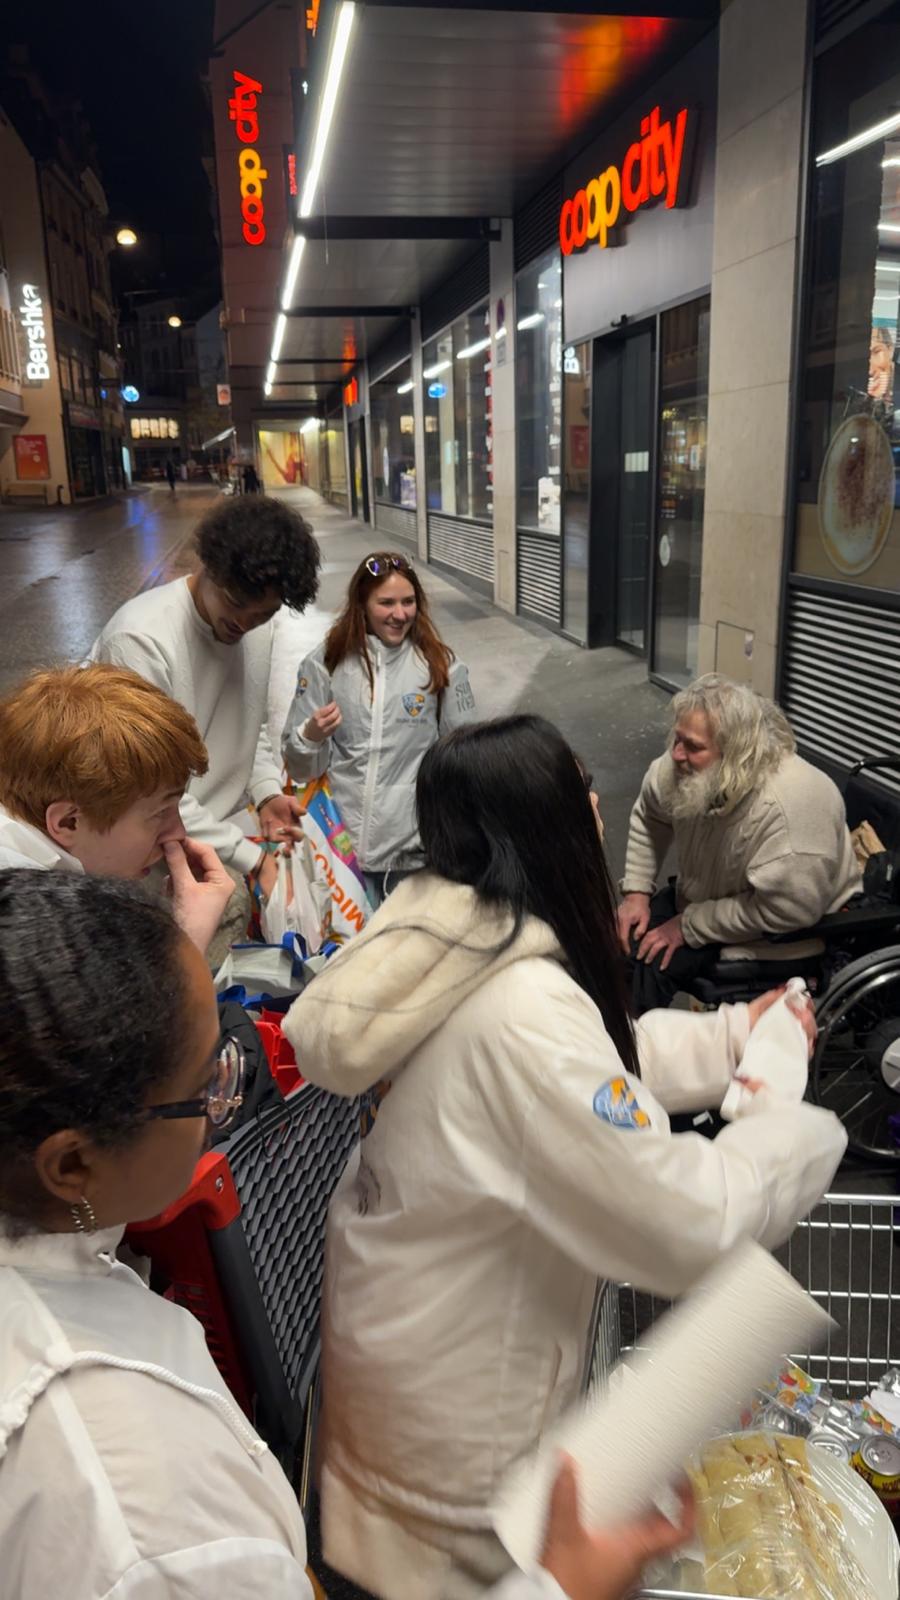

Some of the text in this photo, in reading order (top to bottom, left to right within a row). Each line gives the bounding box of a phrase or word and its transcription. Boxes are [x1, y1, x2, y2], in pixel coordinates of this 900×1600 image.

[228, 70, 268, 246] coop city
[559, 105, 688, 257] coop city
[19, 283, 51, 380] Bershka
